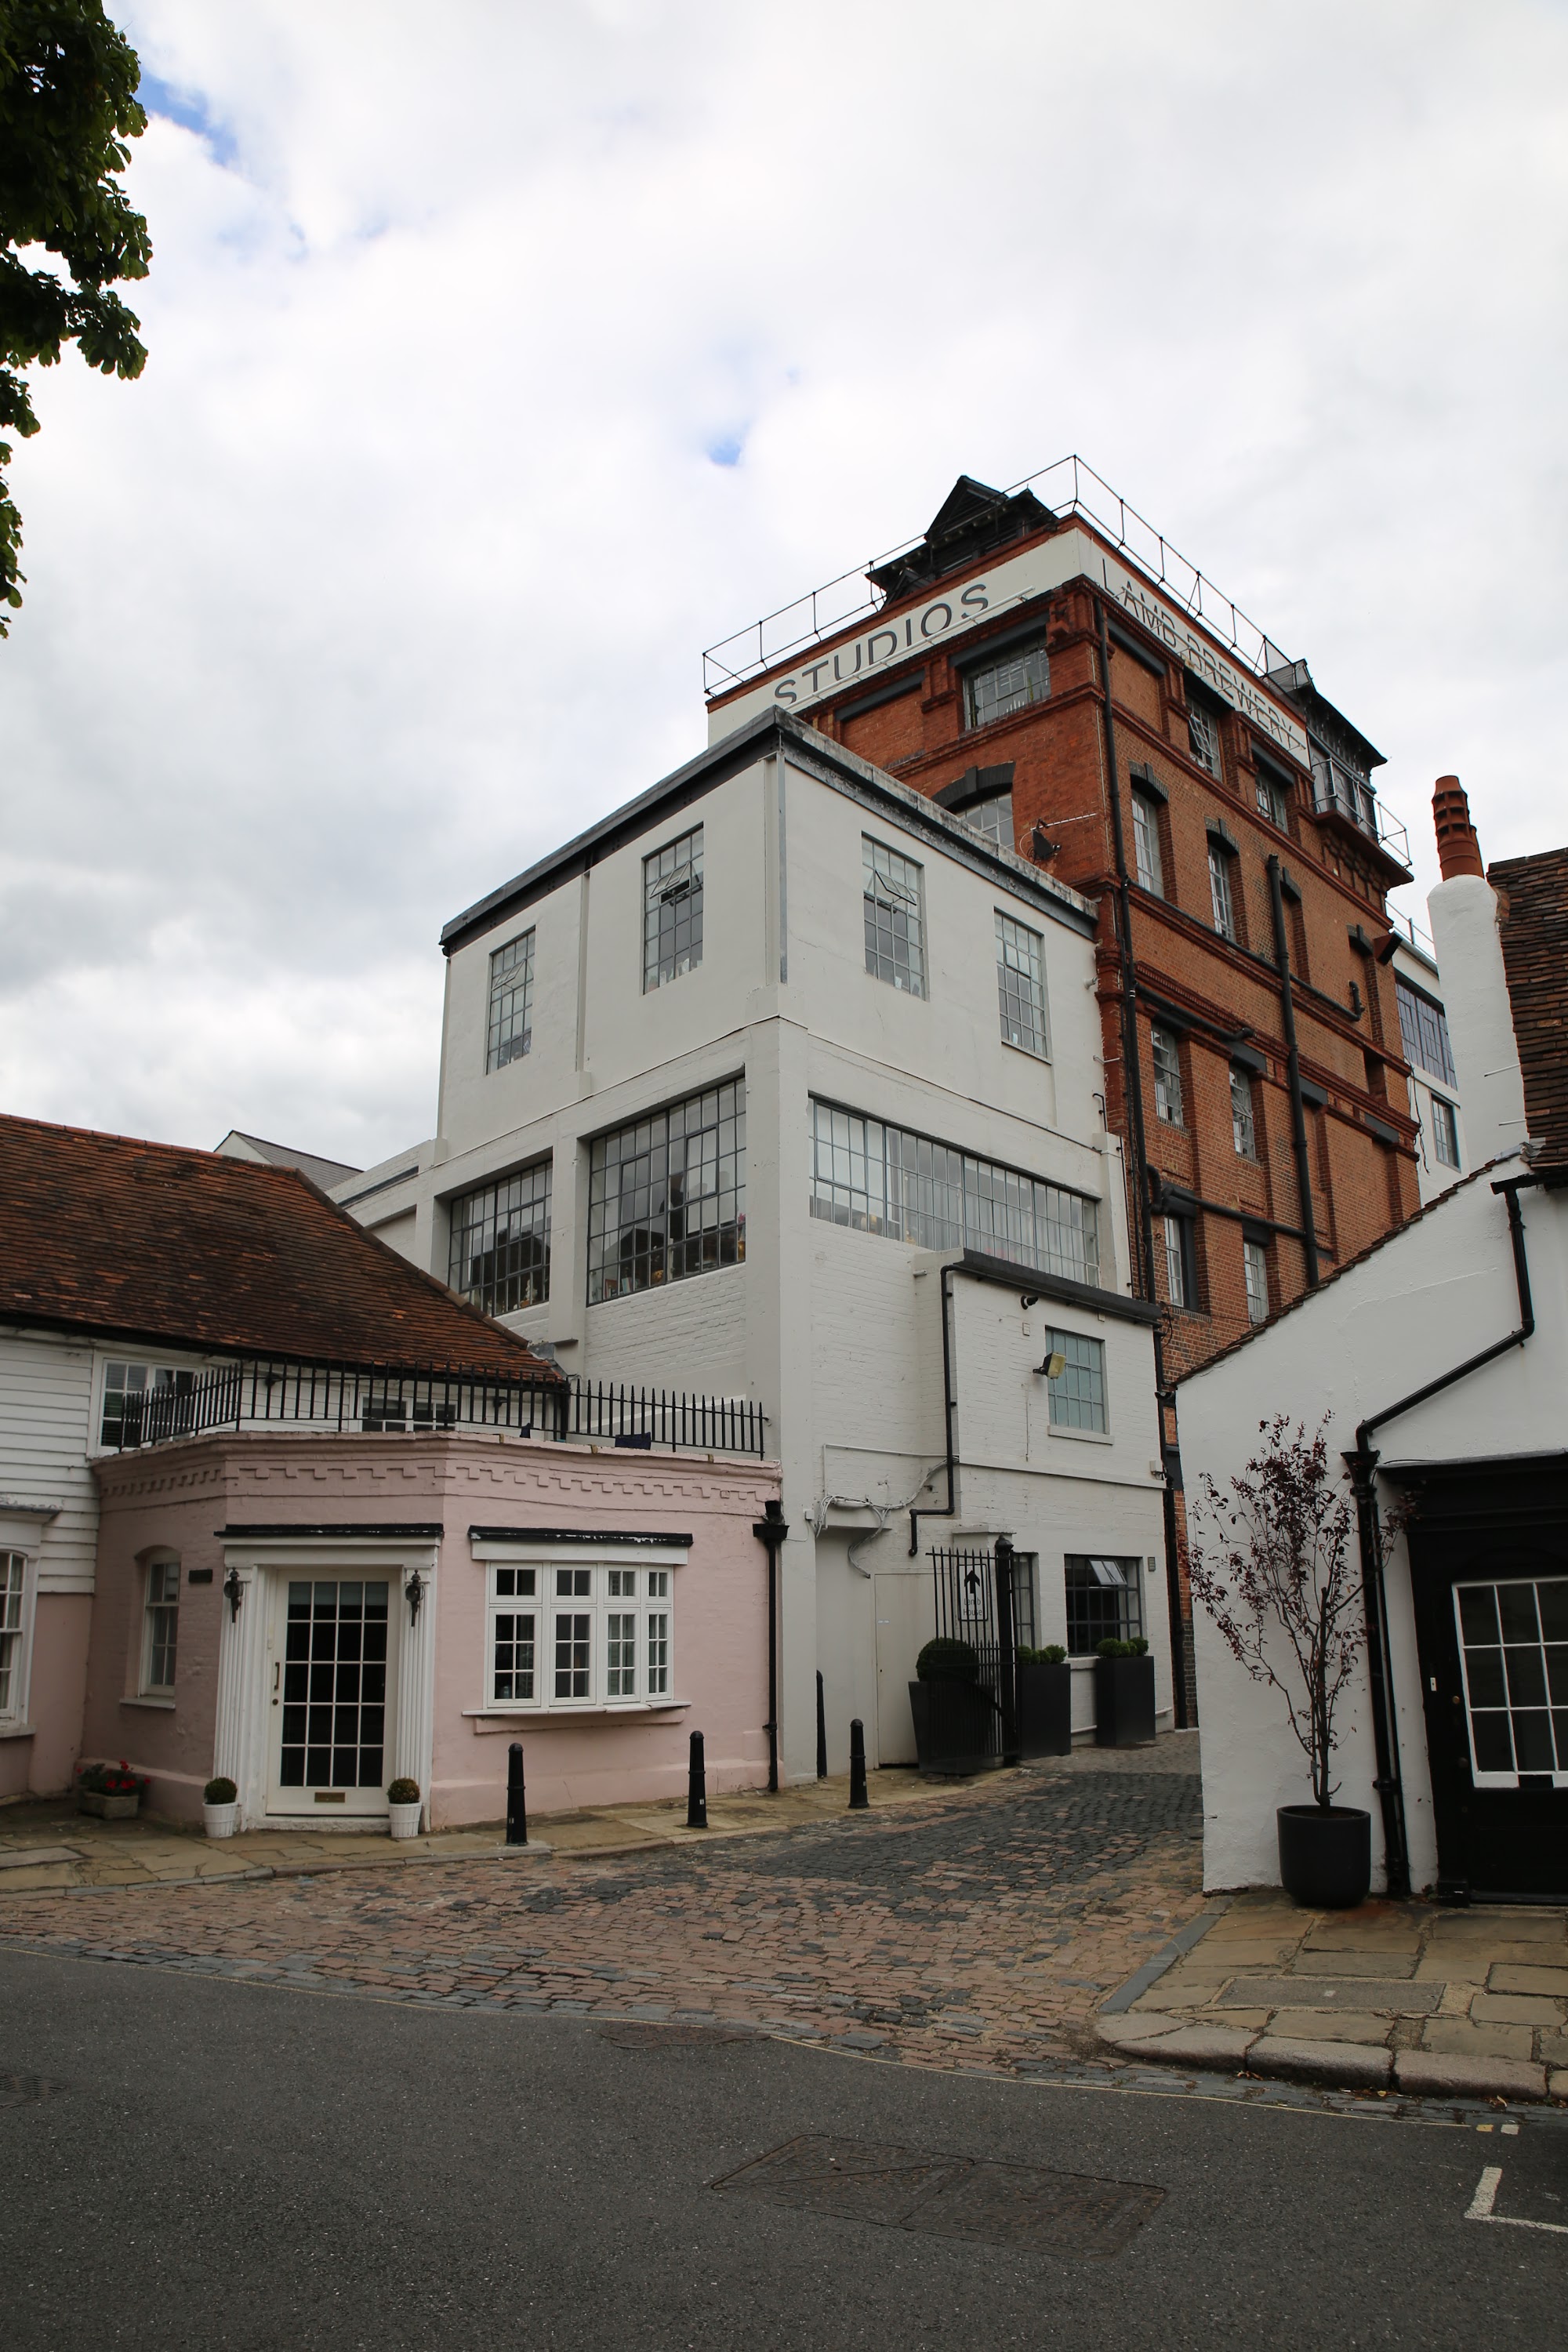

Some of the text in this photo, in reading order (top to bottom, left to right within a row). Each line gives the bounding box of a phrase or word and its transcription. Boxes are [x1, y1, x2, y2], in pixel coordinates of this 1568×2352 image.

[774, 583, 989, 706] STUDIOS
[1102, 558, 1292, 749] LAMB BREWERY
